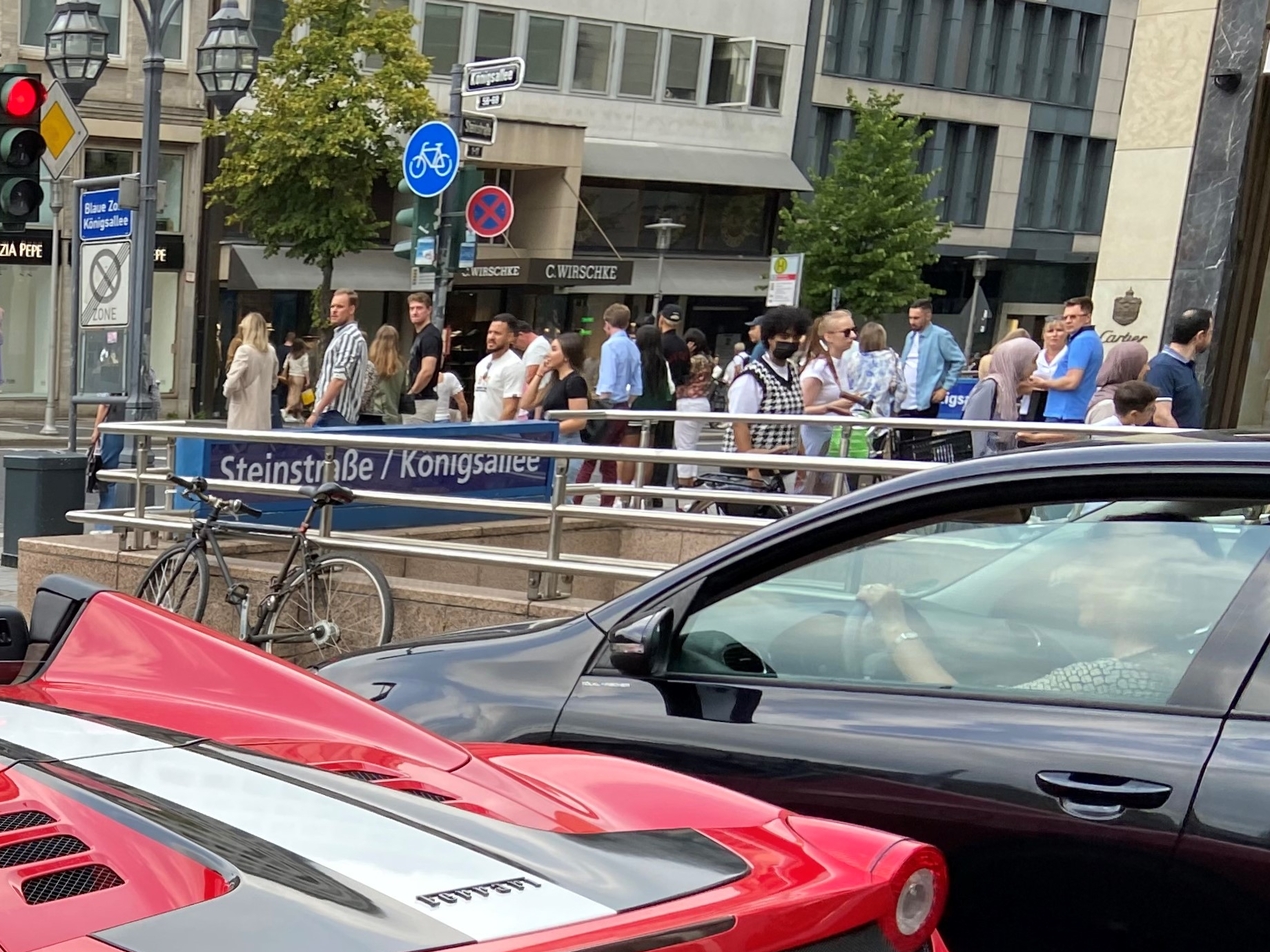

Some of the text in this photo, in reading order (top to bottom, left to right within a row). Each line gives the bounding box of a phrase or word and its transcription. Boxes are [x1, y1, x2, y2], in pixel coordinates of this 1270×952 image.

[470, 69, 514, 86] Königsallee
[85, 200, 123, 214] Blaue Zo
[84, 215, 129, 231] Königsallee
[19, 242, 43, 258] PEPE
[93, 307, 117, 321] ZONE
[1100, 330, 1148, 343] Cartier
